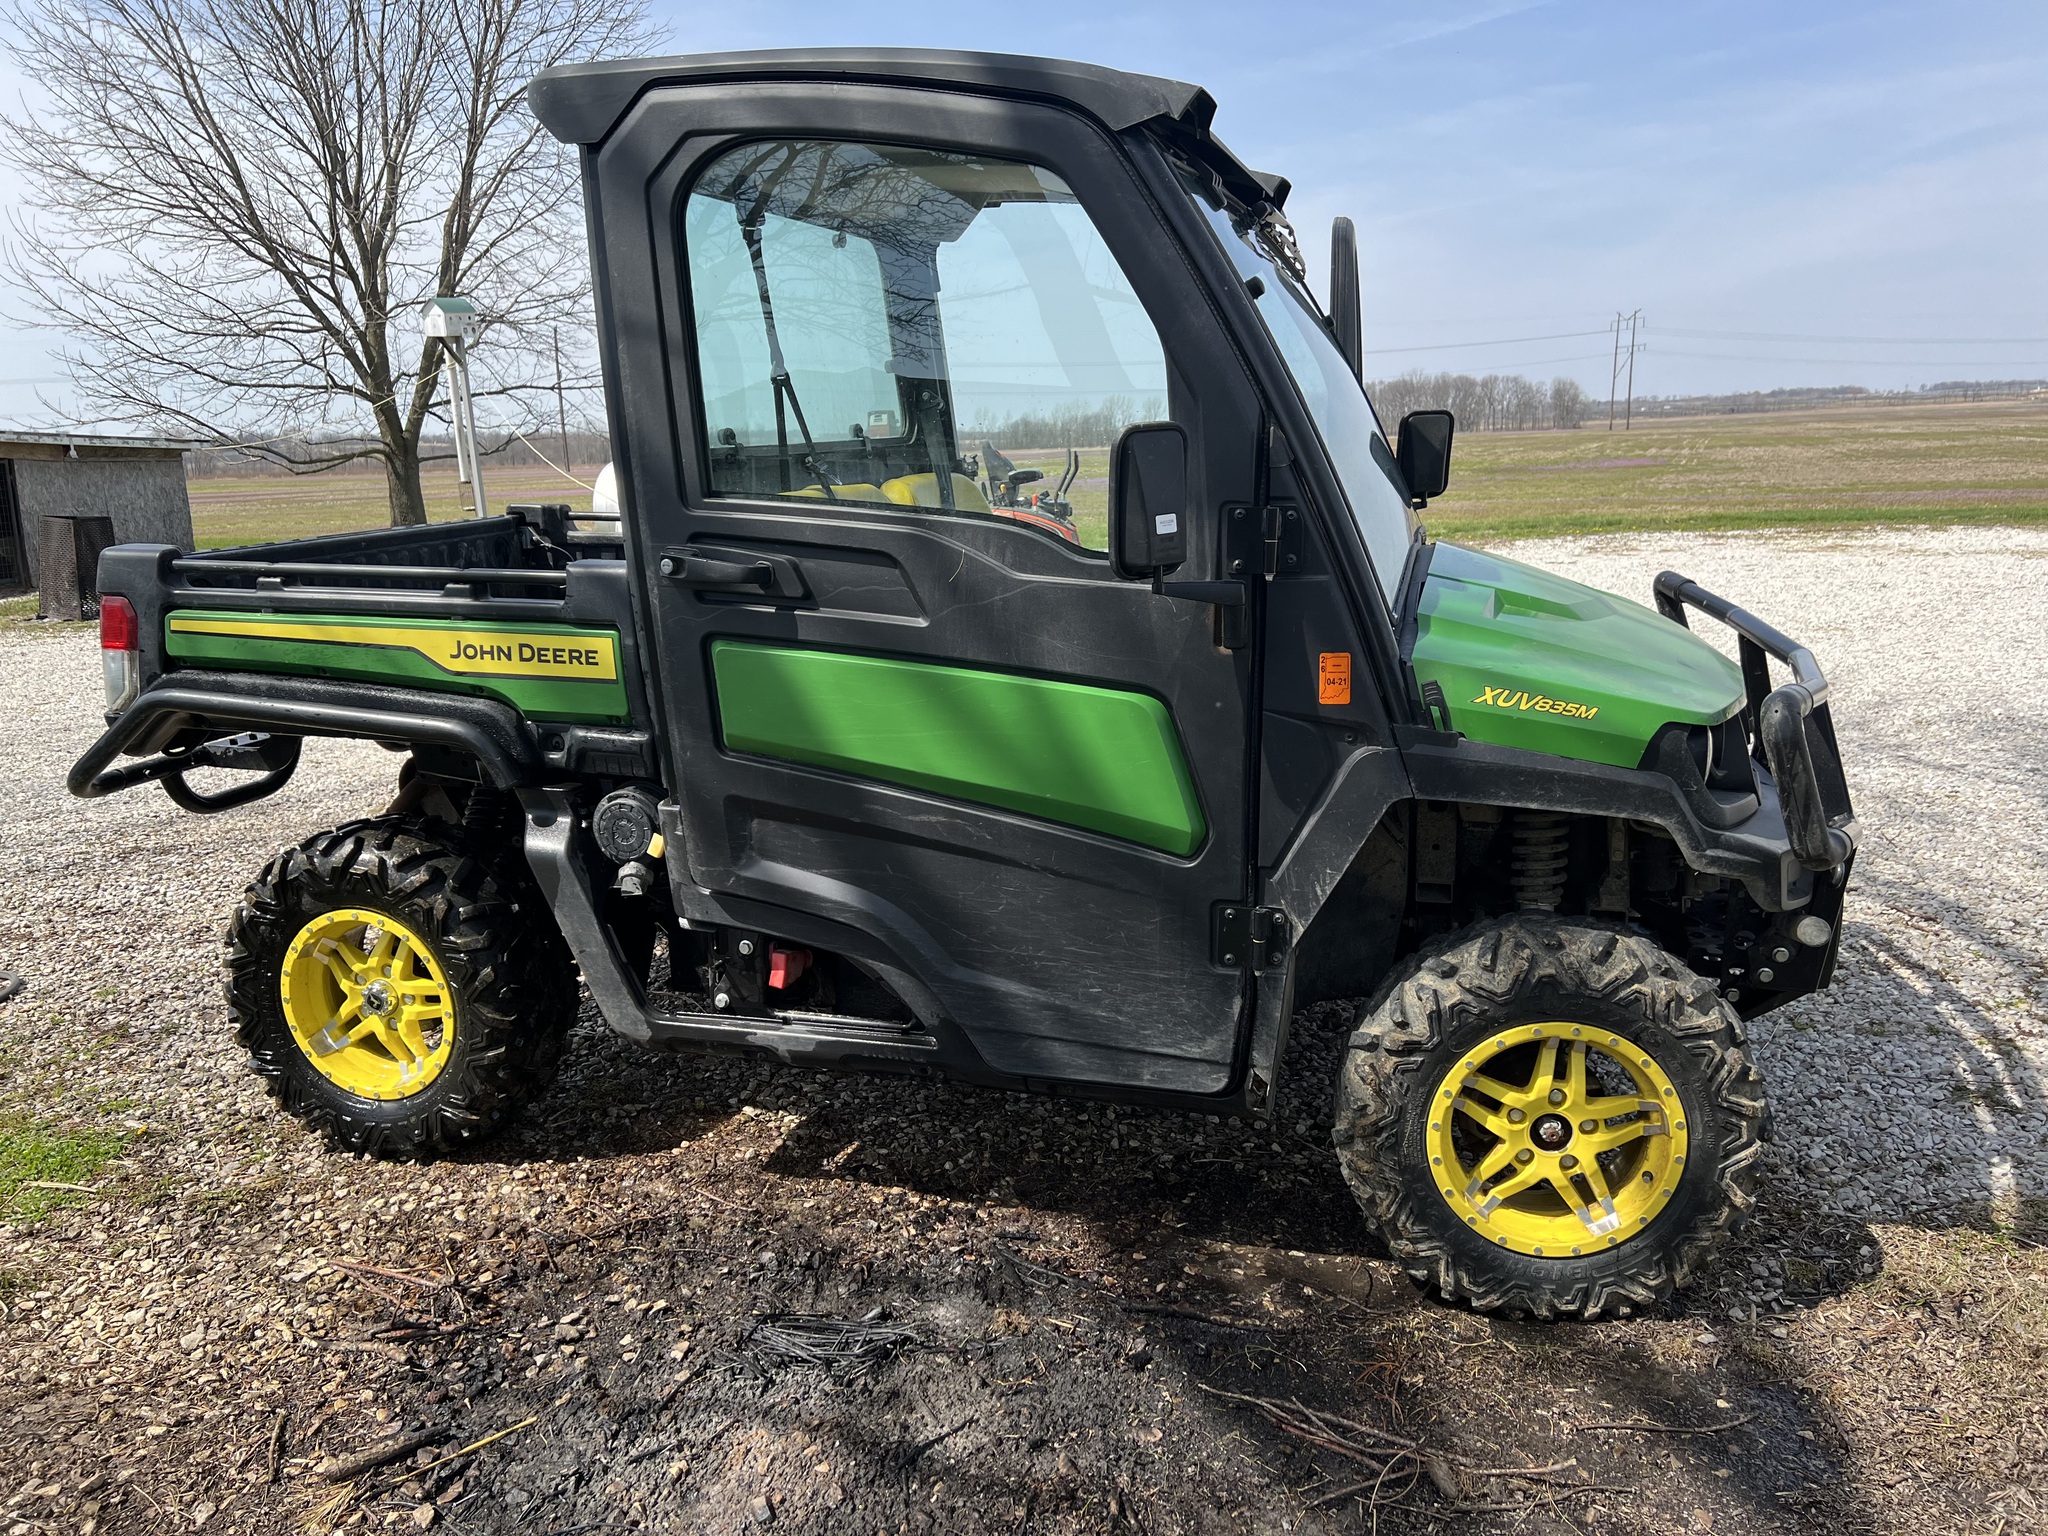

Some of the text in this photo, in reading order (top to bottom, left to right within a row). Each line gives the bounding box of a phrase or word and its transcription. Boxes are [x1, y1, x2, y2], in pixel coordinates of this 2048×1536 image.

[450, 640, 599, 666] JOHN DEERE
[1326, 677, 1347, 686] 04-21
[1472, 686, 1600, 720] XUV835M
